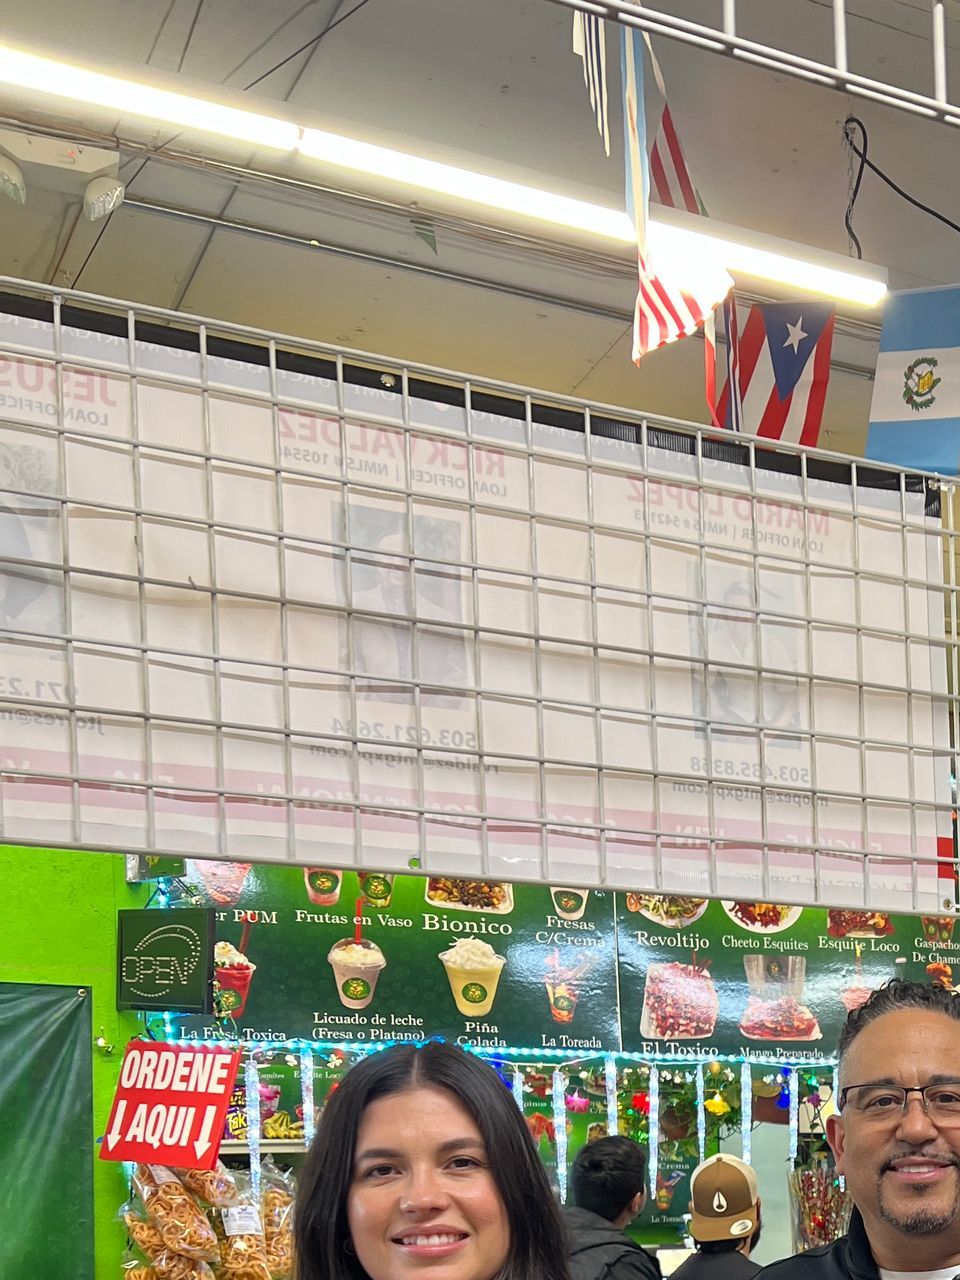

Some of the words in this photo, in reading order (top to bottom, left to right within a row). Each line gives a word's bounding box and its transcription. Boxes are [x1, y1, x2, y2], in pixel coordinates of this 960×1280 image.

[294, 910, 347, 926] Frutas
[352, 914, 373, 926] en
[377, 914, 413, 929] Vaso
[421, 913, 513, 937] Bionico
[546, 916, 596, 931] Fresas
[535, 931, 606, 948] C/Crema
[635, 929, 710, 950] Revoltijo
[722, 935, 762, 949] Cheeto
[763, 938, 809, 952] Esquites
[818, 935, 867, 953] Esquite
[871, 939, 900, 953] Loco
[912, 951, 926, 963] De
[122, 955, 198, 986] OPEN
[313, 1012, 361, 1027] Licuado
[365, 1014, 376, 1027] de
[380, 1014, 424, 1028] leche
[464, 1021, 499, 1034] Piña
[180, 1026, 198, 1039] La
[202, 1027, 238, 1040] Frsa
[242, 1027, 287, 1042] Toxica
[311, 1027, 347, 1041] (Fresa
[350, 1030, 358, 1039] o
[361, 1028, 425, 1042] Platano)
[541, 1034, 556, 1047] La
[560, 1034, 603, 1049] Toreada
[457, 1036, 507, 1049] Colada
[641, 1042, 662, 1058] El
[666, 1042, 719, 1058] Toxico
[740, 1048, 773, 1060] Mango
[776, 1048, 824, 1060] Preparado
[120, 1049, 231, 1094] ORDENE
[125, 1103, 196, 1149] AQUI
